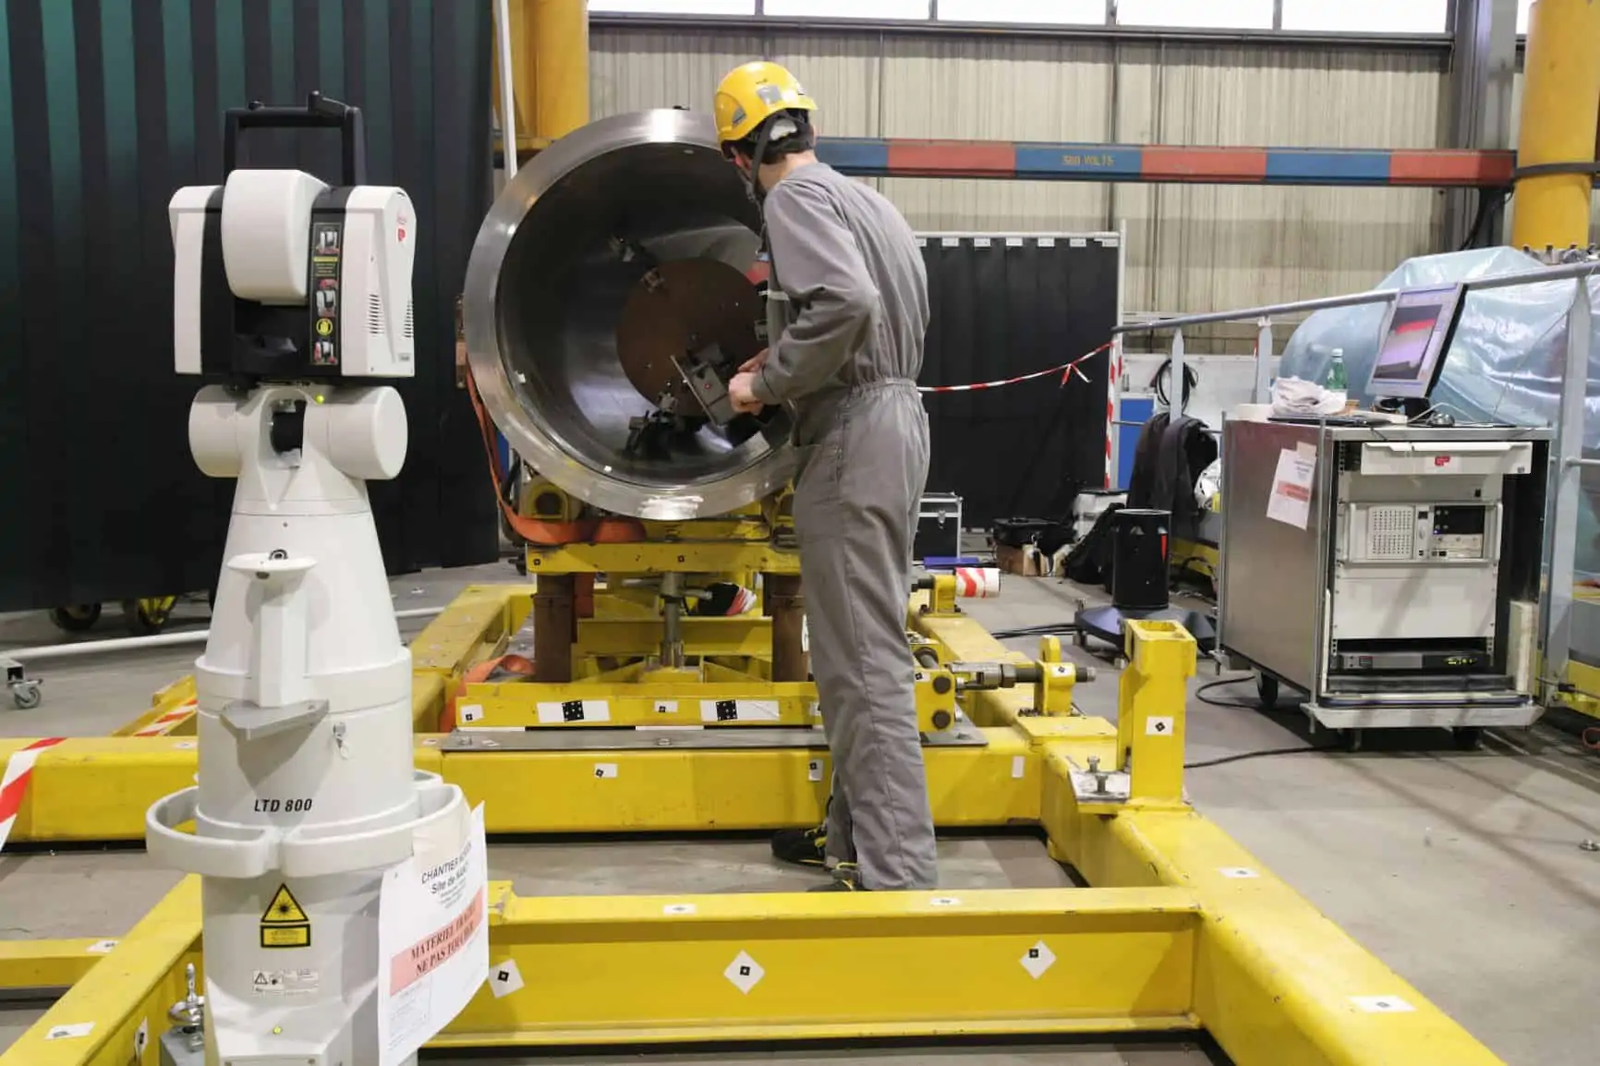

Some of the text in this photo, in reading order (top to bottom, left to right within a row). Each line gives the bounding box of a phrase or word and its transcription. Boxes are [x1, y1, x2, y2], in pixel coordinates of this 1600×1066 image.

[254, 798, 313, 812] LTD 800
[416, 960, 428, 976] NE
[429, 950, 446, 968] PAS
